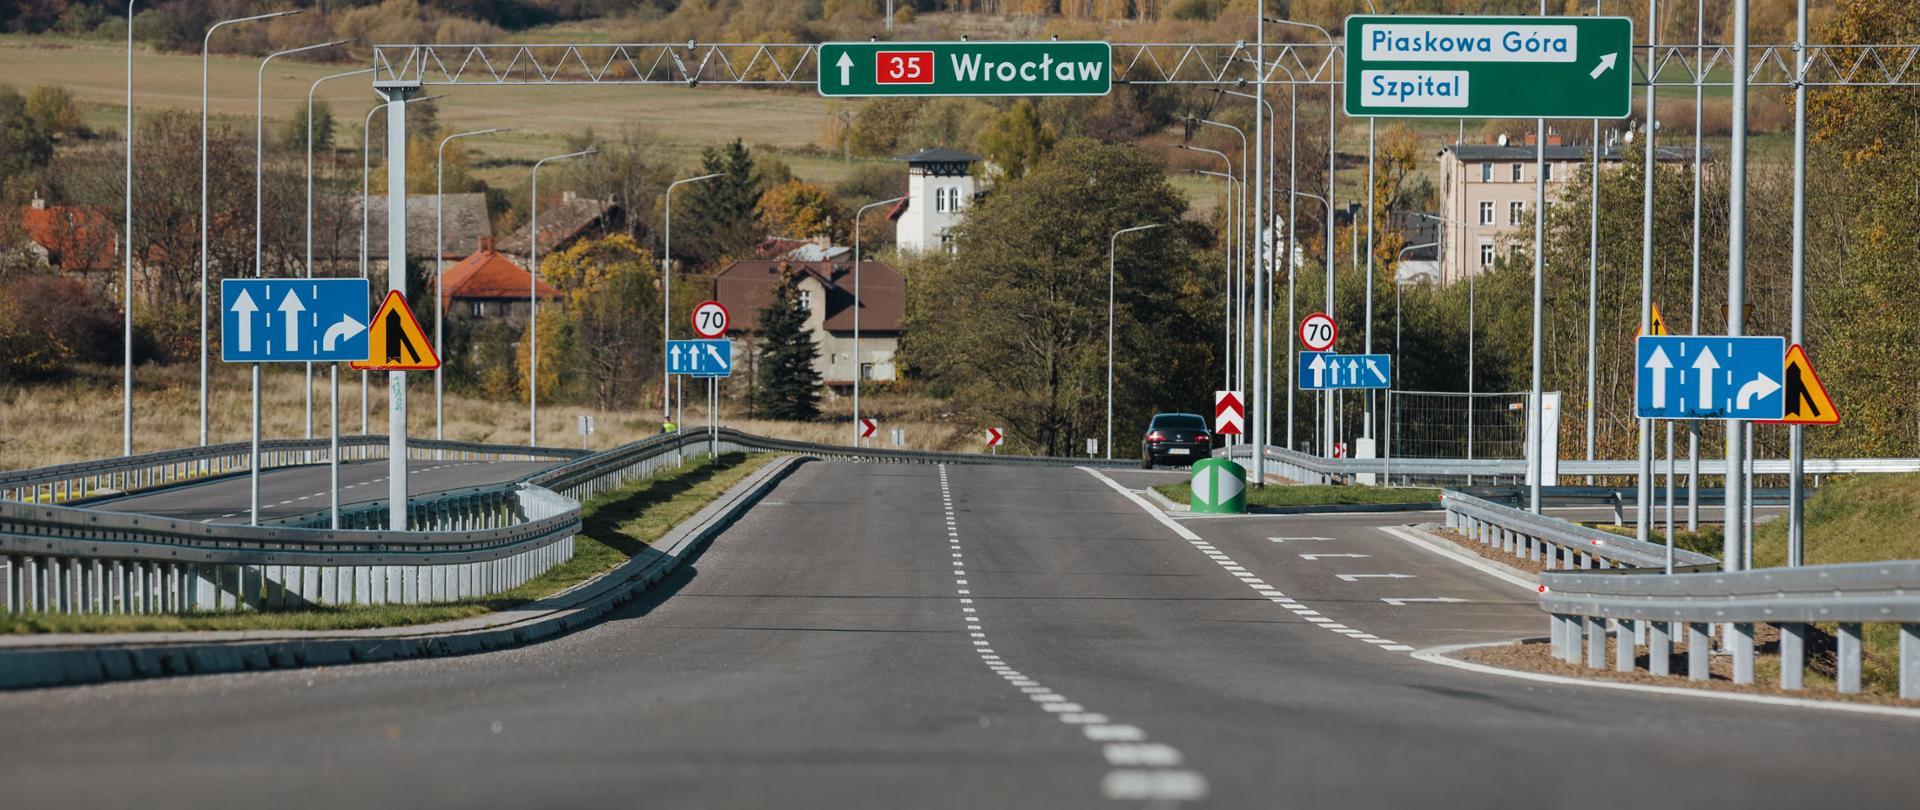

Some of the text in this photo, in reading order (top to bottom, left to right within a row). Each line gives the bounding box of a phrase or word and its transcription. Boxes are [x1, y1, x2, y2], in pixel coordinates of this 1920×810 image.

[1372, 30, 1568, 53] Piaskowa Góra
[890, 53, 1103, 81] 35 Wrocław
[1371, 75, 1459, 102] Szpital
[700, 311, 724, 329] 70
[1308, 324, 1332, 341] 70
